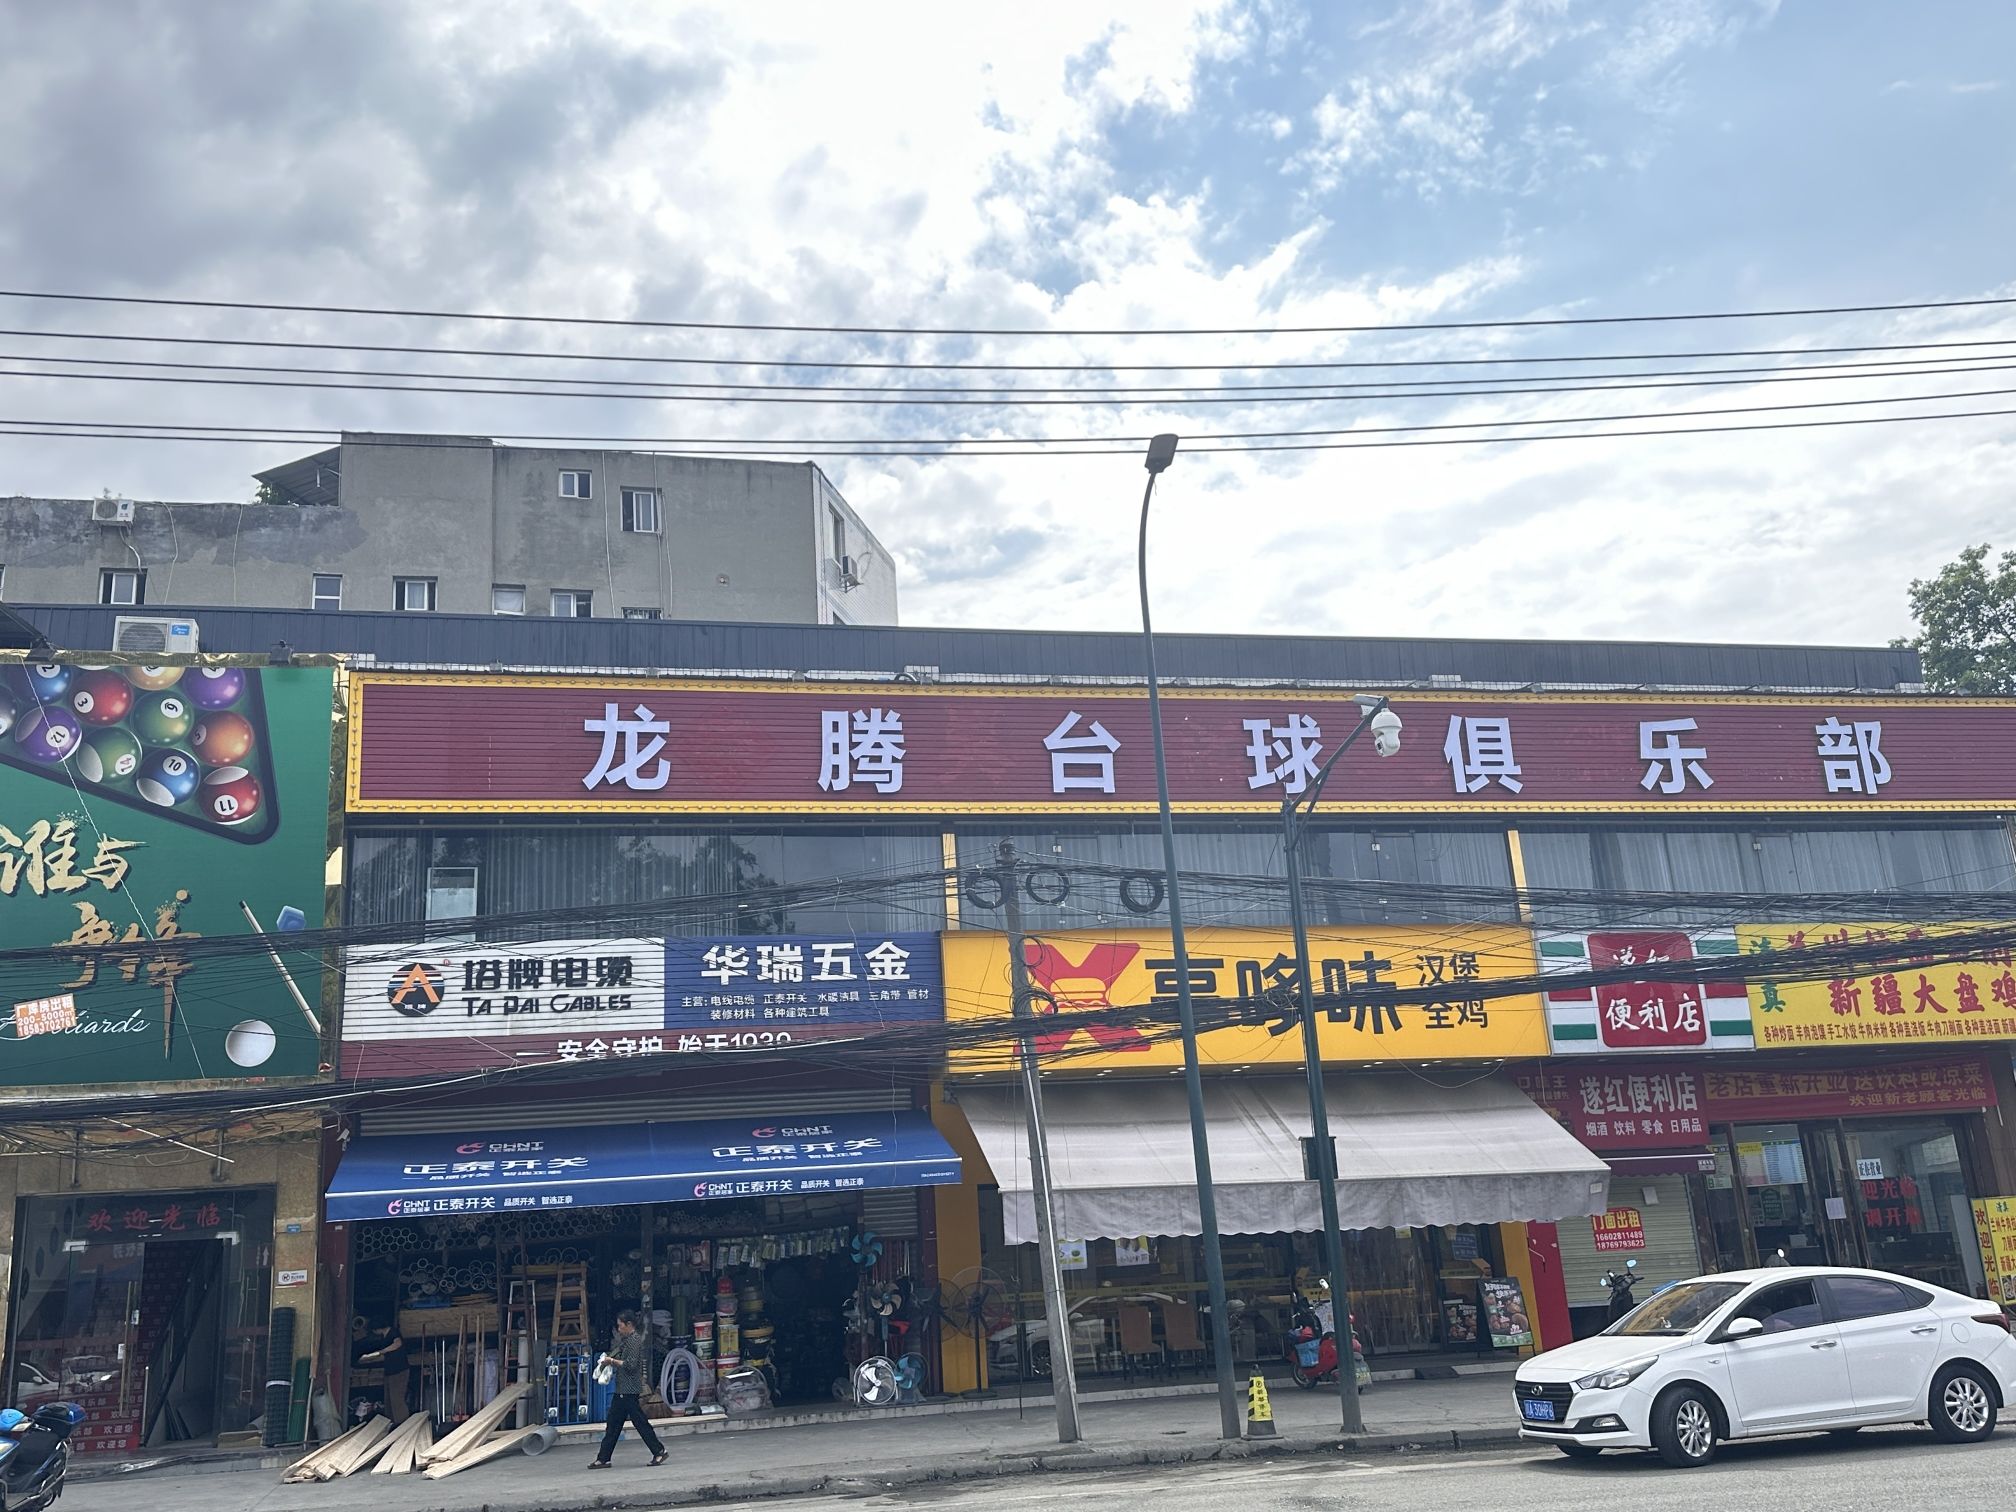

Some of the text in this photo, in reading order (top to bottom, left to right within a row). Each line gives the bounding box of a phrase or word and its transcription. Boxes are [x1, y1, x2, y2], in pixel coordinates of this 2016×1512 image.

[581, 701, 1893, 797] 龙腾台球俱乐部
[169, 759, 182, 772] 10
[218, 800, 234, 812] 11
[701, 941, 911, 986] 华瑞五金
[1416, 952, 1480, 986] 汉堡
[710, 1005, 830, 1021] 装修材料 各种建筑工具
[1606, 993, 1701, 1033] 便利店
[1579, 1071, 1699, 1115] 遂红便利店
[1849, 1087, 1987, 1107] 欢迎新老顾客光临
[1585, 1117, 1702, 1136] 烟酒 饮料 零食 日用品
[712, 1138, 883, 1157] 正泰开关
[403, 1156, 589, 1174] 正泰开关
[736, 1180, 793, 1193] 正泰开关
[800, 1179, 830, 1189] 品质开关
[433, 1196, 496, 1211] 正泰开关
[503, 1197, 536, 1207] 品质开关
[87, 1202, 220, 1232] 欢迎光临
[1592, 1210, 1641, 1231] 门面出租
[1595, 1231, 1643, 1241] 16602811489
[1975, 1208, 2000, 1296] 欢迎光临
